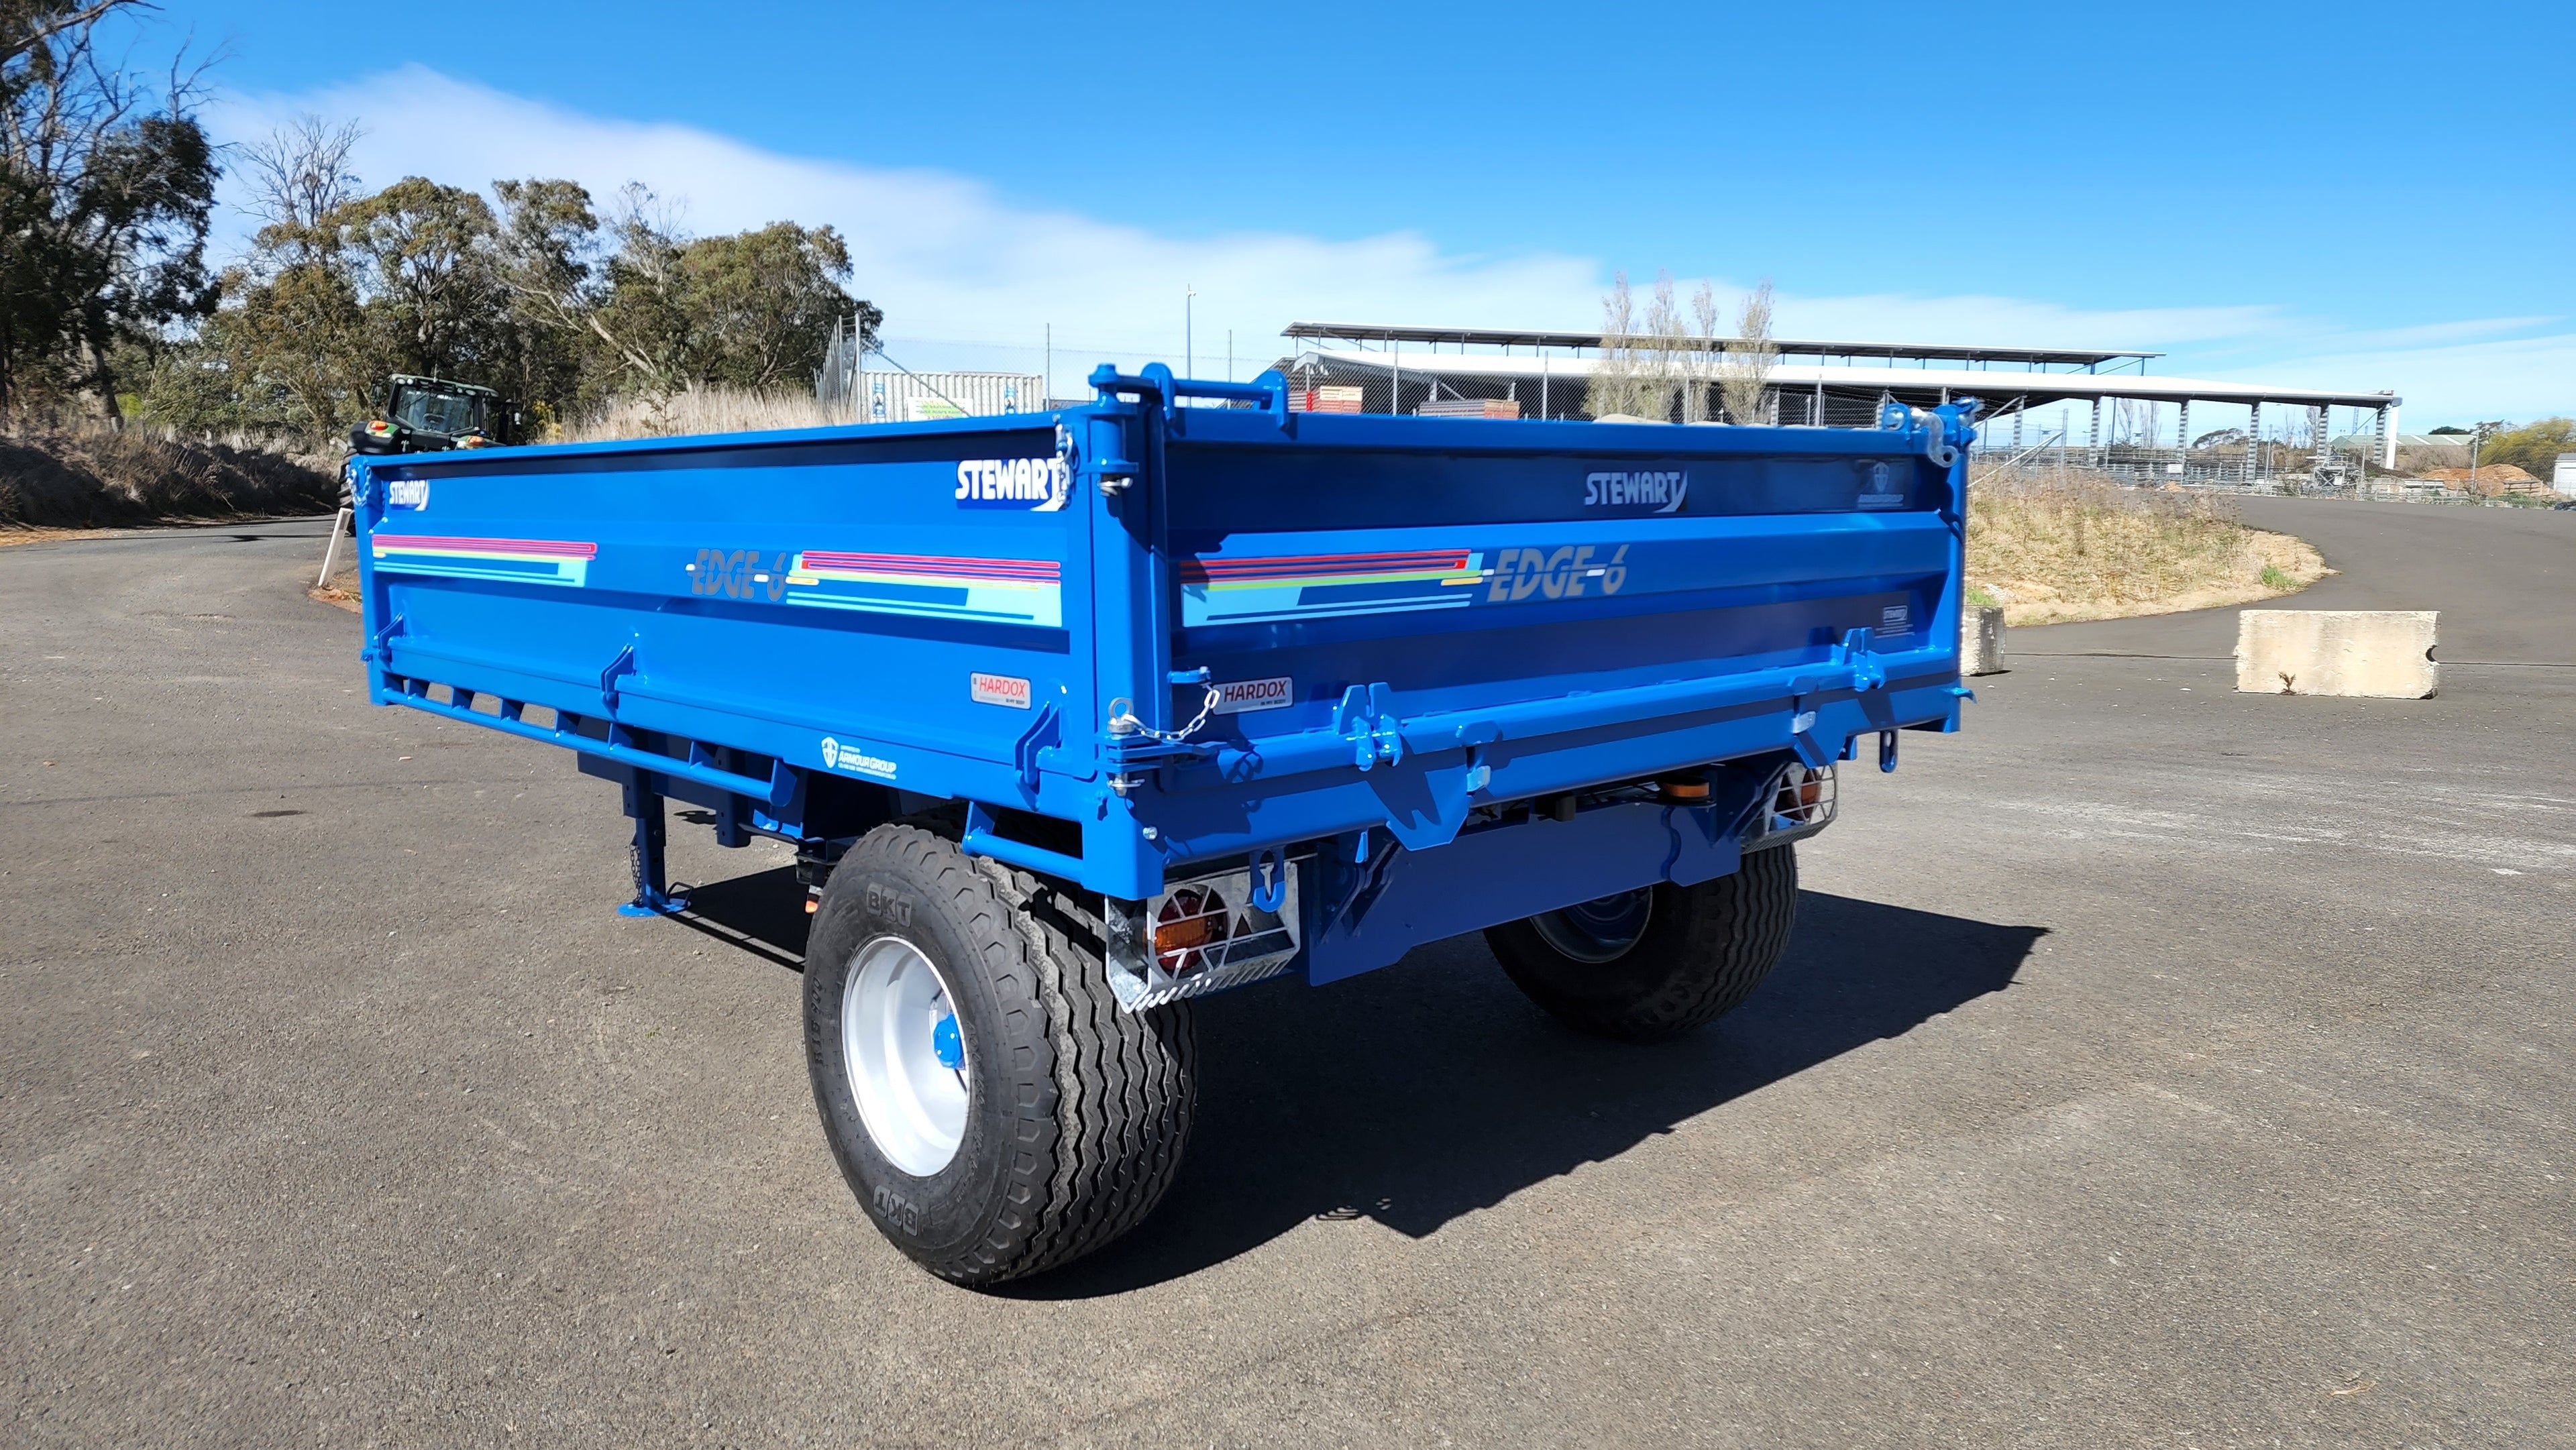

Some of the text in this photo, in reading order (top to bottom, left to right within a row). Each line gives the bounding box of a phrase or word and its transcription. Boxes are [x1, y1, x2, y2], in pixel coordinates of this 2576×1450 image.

[389, 479, 429, 512] STEWART
[955, 458, 1064, 512] STEWART
[1585, 470, 1687, 513] STEWART
[979, 677, 1026, 698] HARDOX
[1224, 680, 1287, 703] HARDOX
[867, 884, 912, 927] BKT
[873, 1186, 919, 1235] BKT
